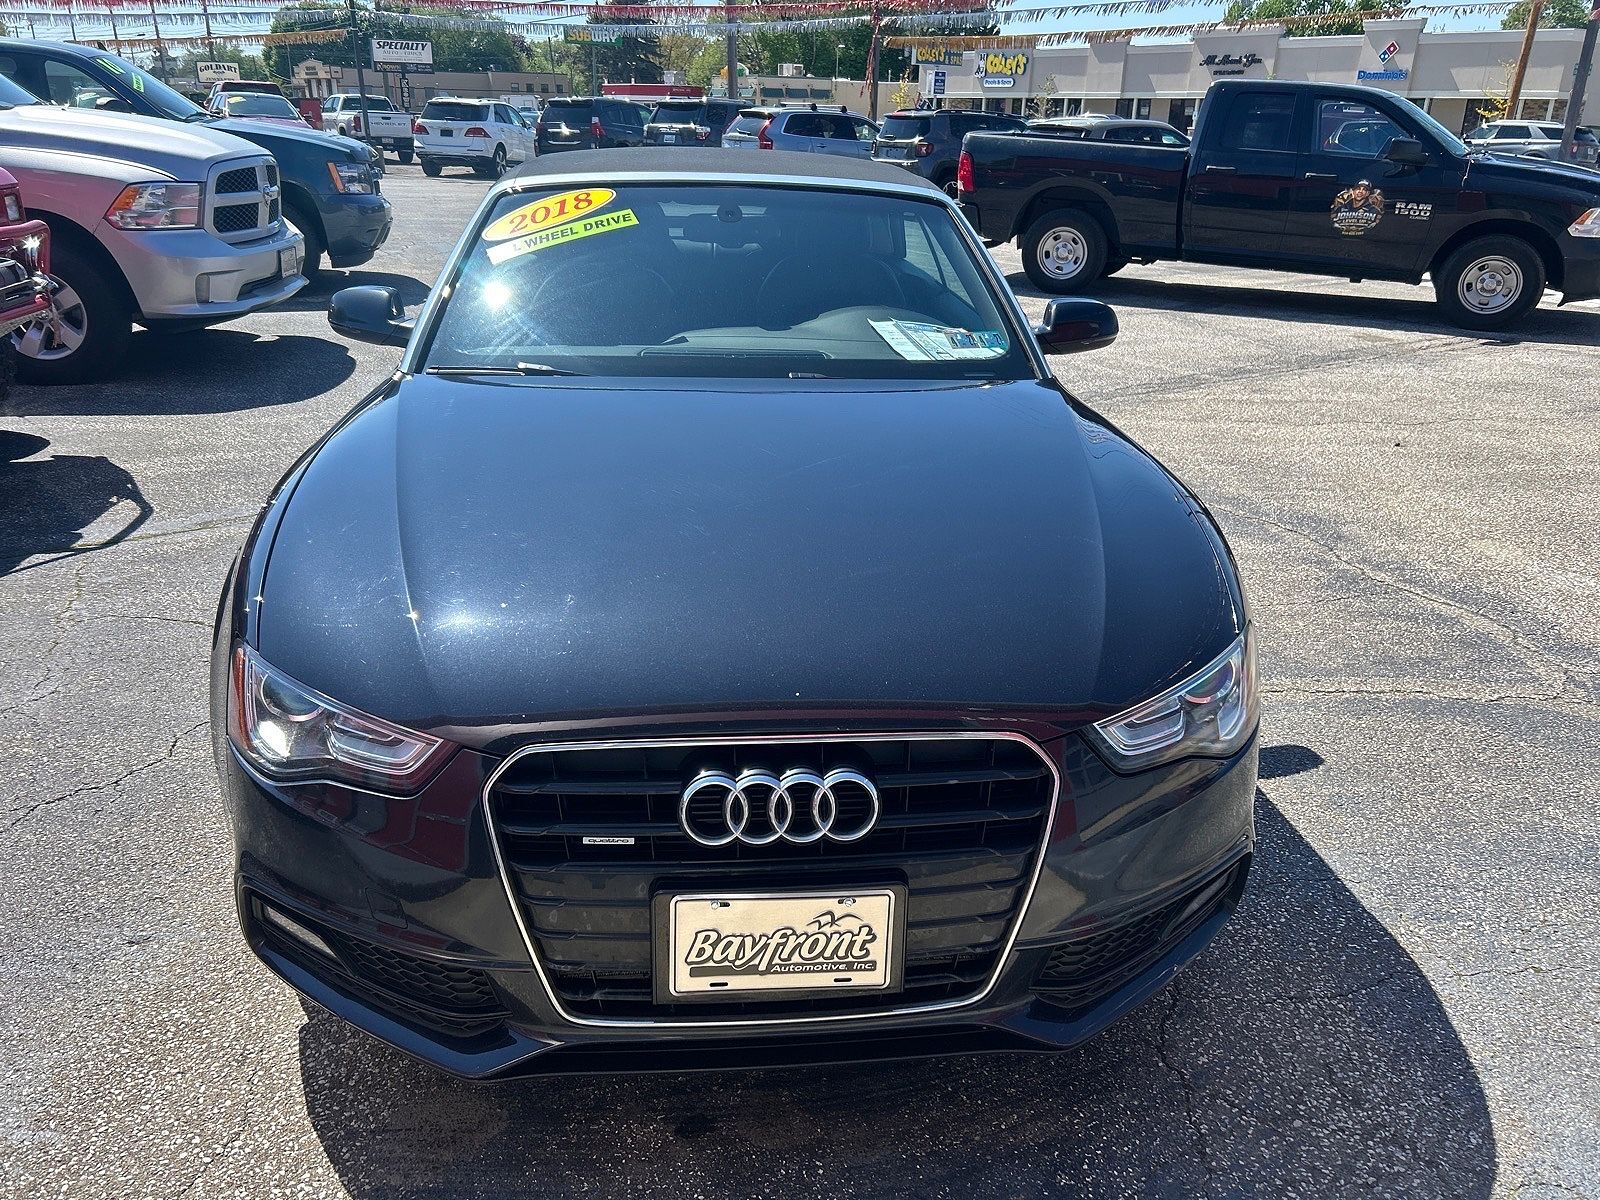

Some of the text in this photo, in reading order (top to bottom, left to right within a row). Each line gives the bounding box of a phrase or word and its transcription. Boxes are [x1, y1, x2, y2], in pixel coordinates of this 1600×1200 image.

[567, 28, 617, 42] SUBWAY
[376, 41, 428, 51] SPECIALTY
[199, 63, 238, 74] GOLDART
[986, 53, 1026, 75] COLLEY'S
[1357, 69, 1408, 81] Domino's
[1395, 202, 1432, 211] RAM
[1395, 208, 1431, 216] 1500
[508, 192, 593, 235] 2018
[1333, 211, 1377, 222] JOHNSON
[524, 212, 633, 249] WHEEL DRIVE
[684, 925, 878, 972] Bayfront
[853, 960, 875, 970] Inc.
